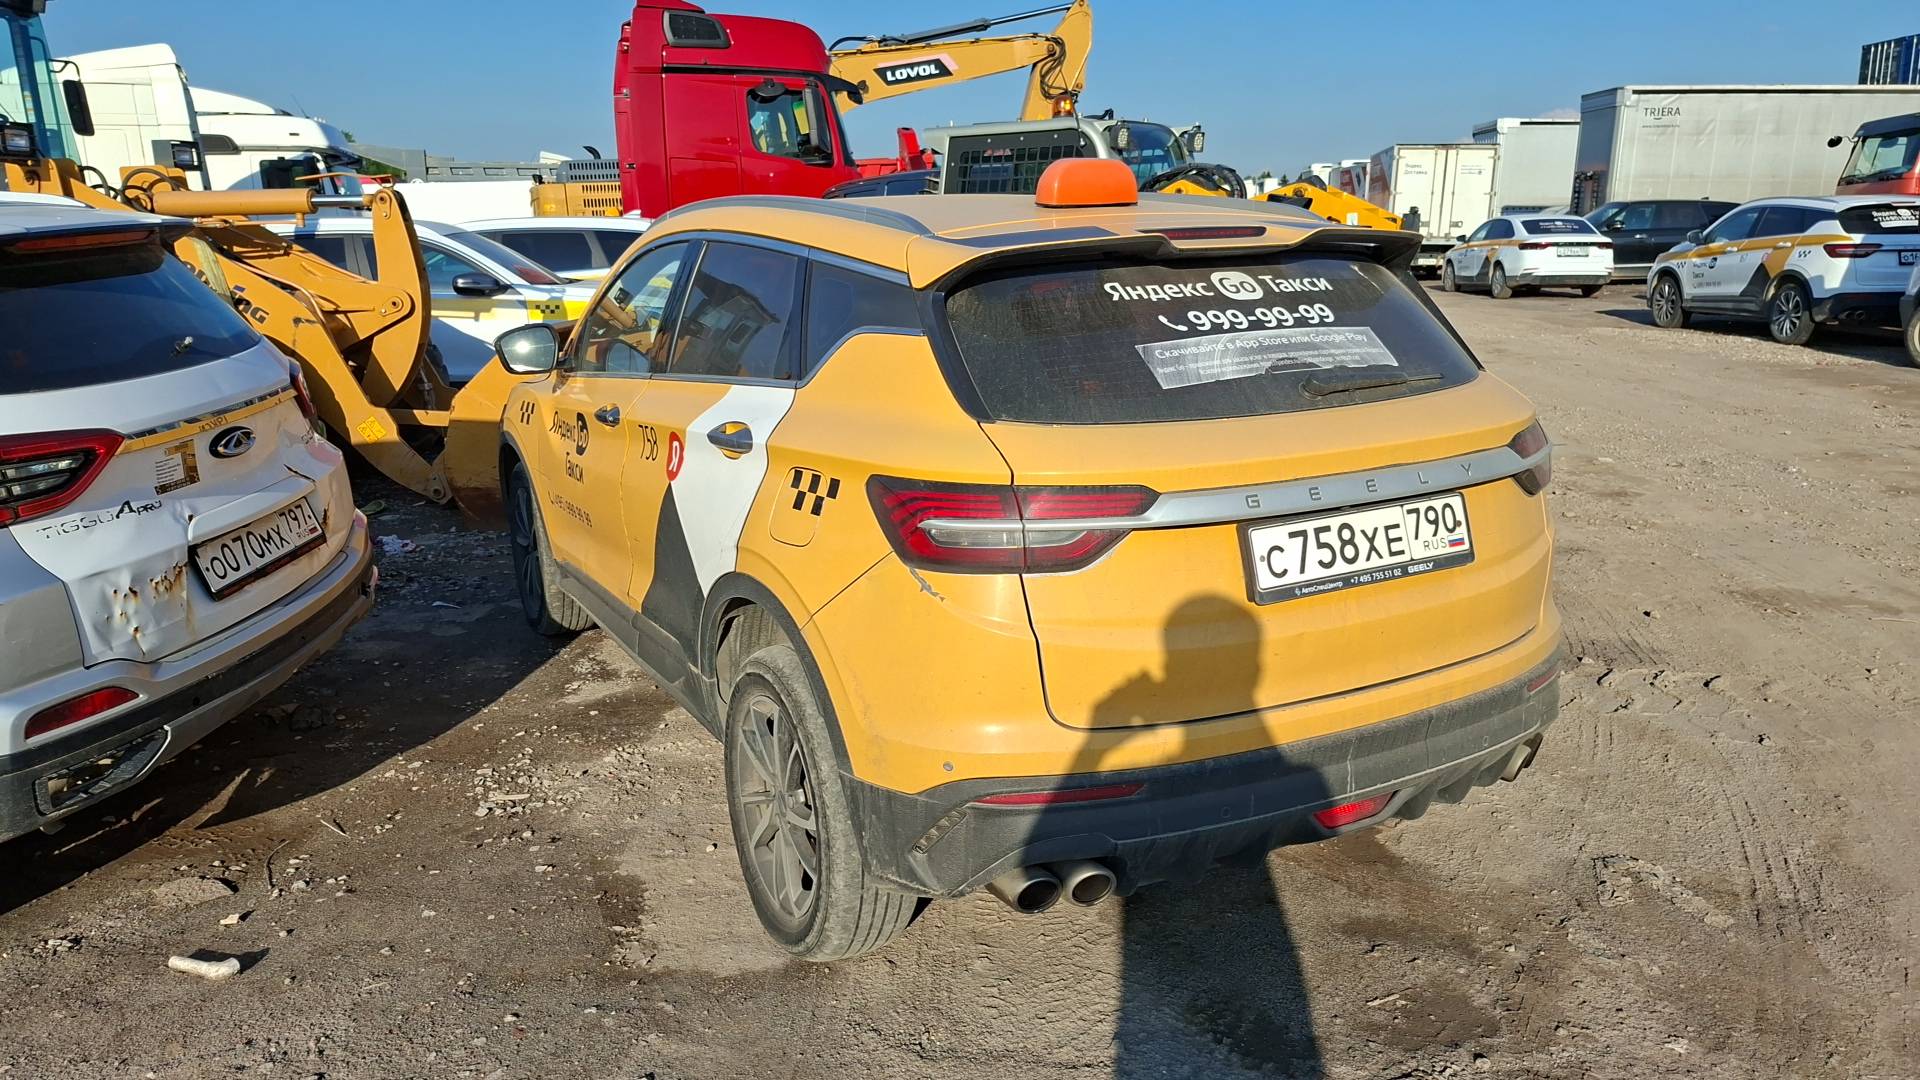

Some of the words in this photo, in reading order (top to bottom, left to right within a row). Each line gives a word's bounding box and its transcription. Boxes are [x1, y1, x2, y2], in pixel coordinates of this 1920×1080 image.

[885, 64, 940, 81] LOVOL
[1643, 107, 1681, 117] TRIERA
[1103, 281, 1214, 302] Яндекс
[1217, 275, 1258, 296] Go
[1258, 274, 1333, 294] Такси
[1187, 303, 1335, 331] 999-99-99
[1155, 342, 1226, 359] Скачивайте
[1235, 339, 1260, 349] App
[1260, 336, 1289, 346] Store
[1289, 336, 1310, 344] или
[1310, 333, 1347, 343] Google
[1345, 332, 1368, 342] Play
[549, 411, 576, 443] Яндекс
[638, 424, 658, 461] 758
[565, 451, 585, 485] Такси
[1246, 463, 1472, 509] GEELY
[279, 504, 309, 534] 797
[1406, 502, 1457, 540] 790
[210, 524, 290, 580] О070МХ
[1266, 522, 1405, 579] С758ХЕ
[1423, 537, 1448, 552] RUS
[1359, 573, 1372, 583] 495
[1372, 571, 1385, 581] 755
[1384, 569, 1393, 578] 51
[1407, 562, 1434, 574] GEELY
